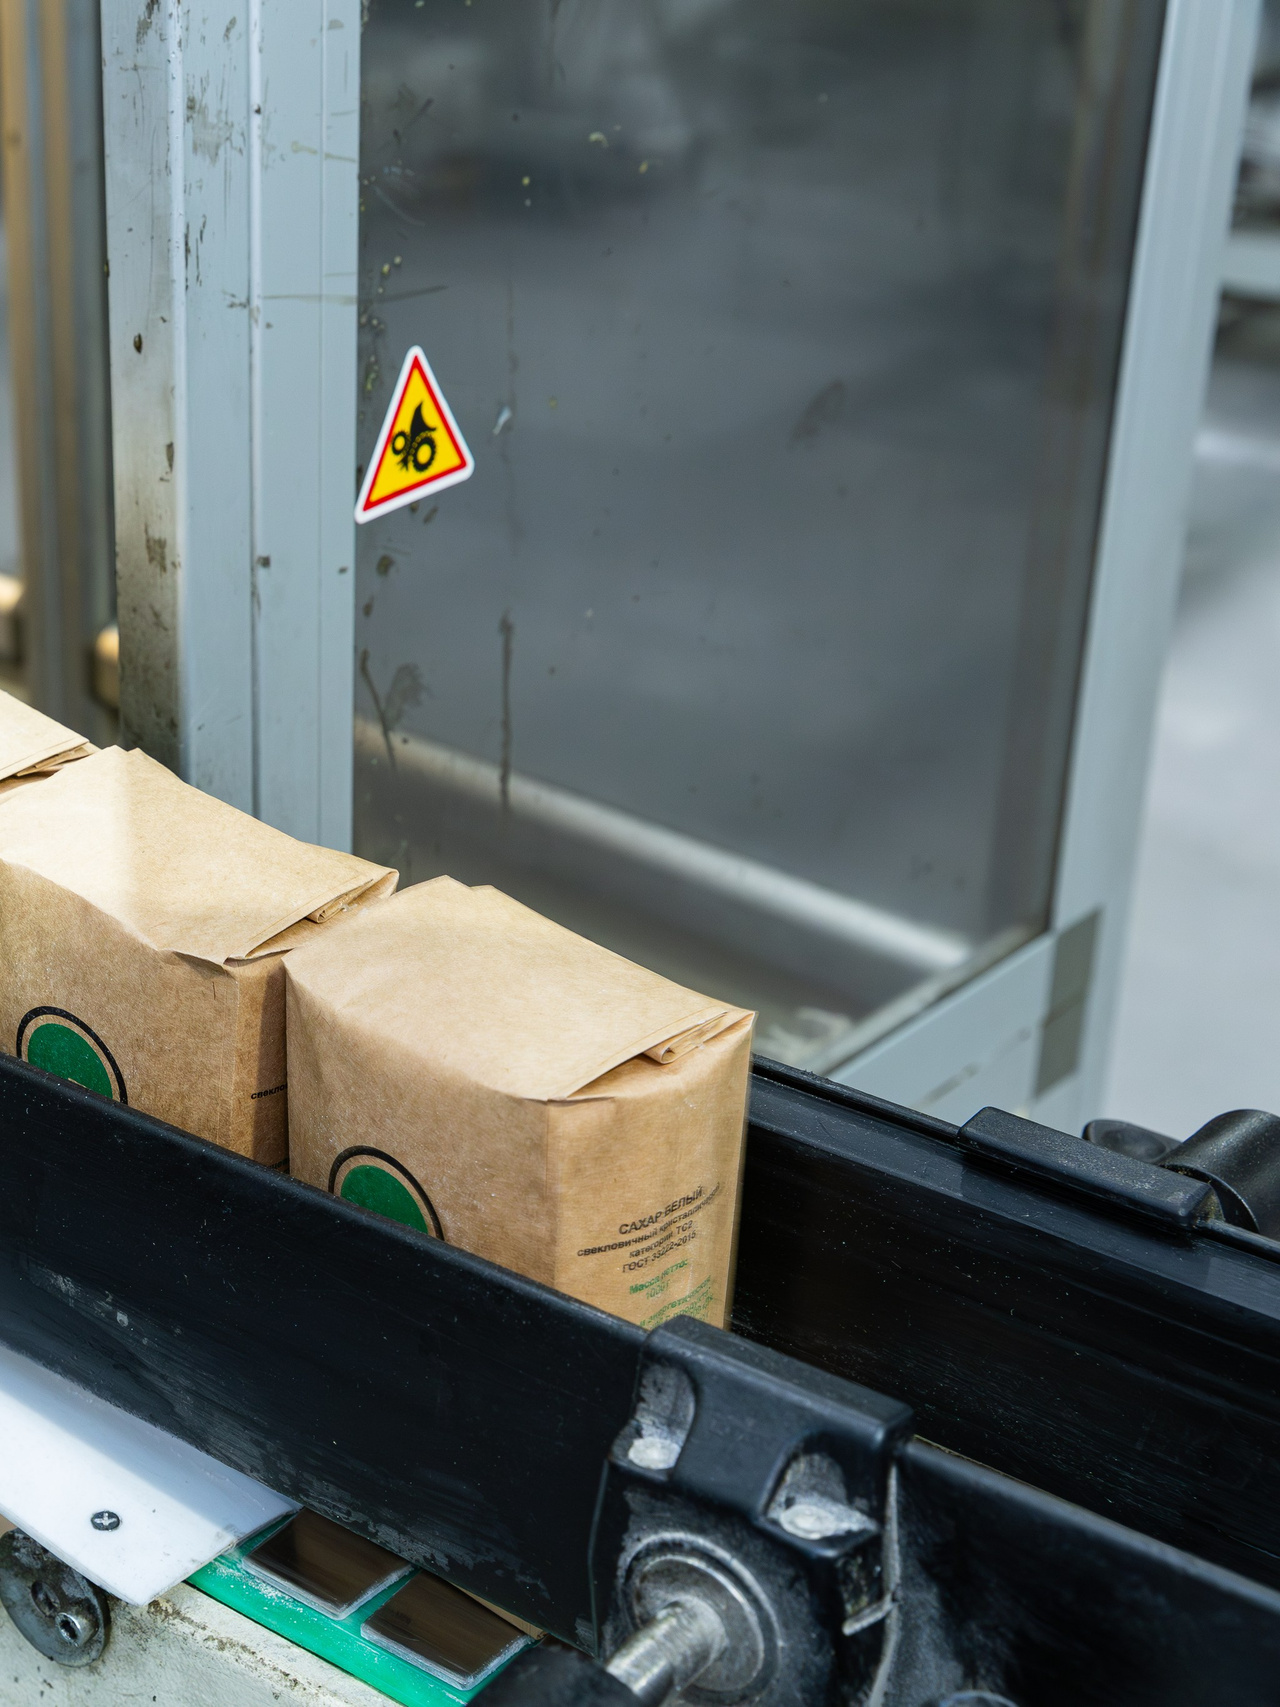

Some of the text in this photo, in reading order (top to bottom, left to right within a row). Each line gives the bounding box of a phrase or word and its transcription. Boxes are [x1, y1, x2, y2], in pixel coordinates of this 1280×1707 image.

[619, 1185, 704, 1235] САХАР БЕЛЫЙ
[577, 1228, 658, 1257] свекловичный
[622, 1255, 651, 1273] ГОСТ
[629, 1275, 660, 1295] Масса
